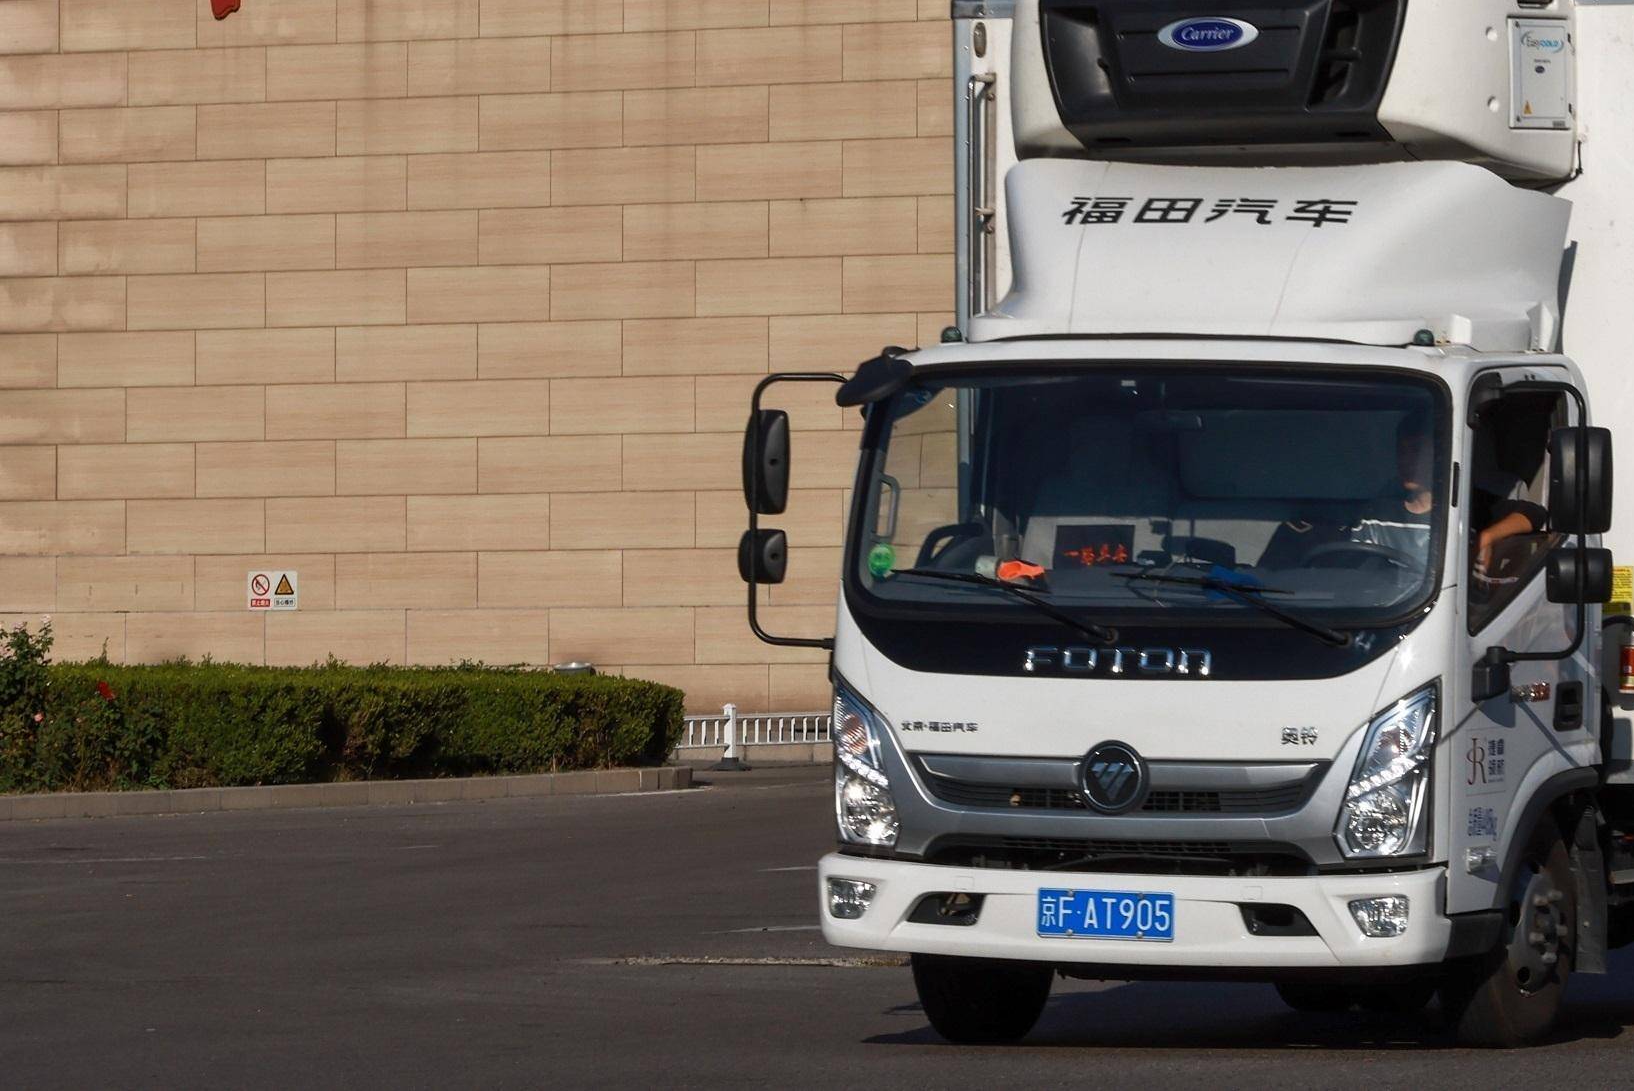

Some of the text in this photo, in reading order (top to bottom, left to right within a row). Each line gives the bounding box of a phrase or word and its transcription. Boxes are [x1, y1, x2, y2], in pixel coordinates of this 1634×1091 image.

[1181, 25, 1235, 42] Carrier
[1061, 196, 1359, 228] 福田汽车
